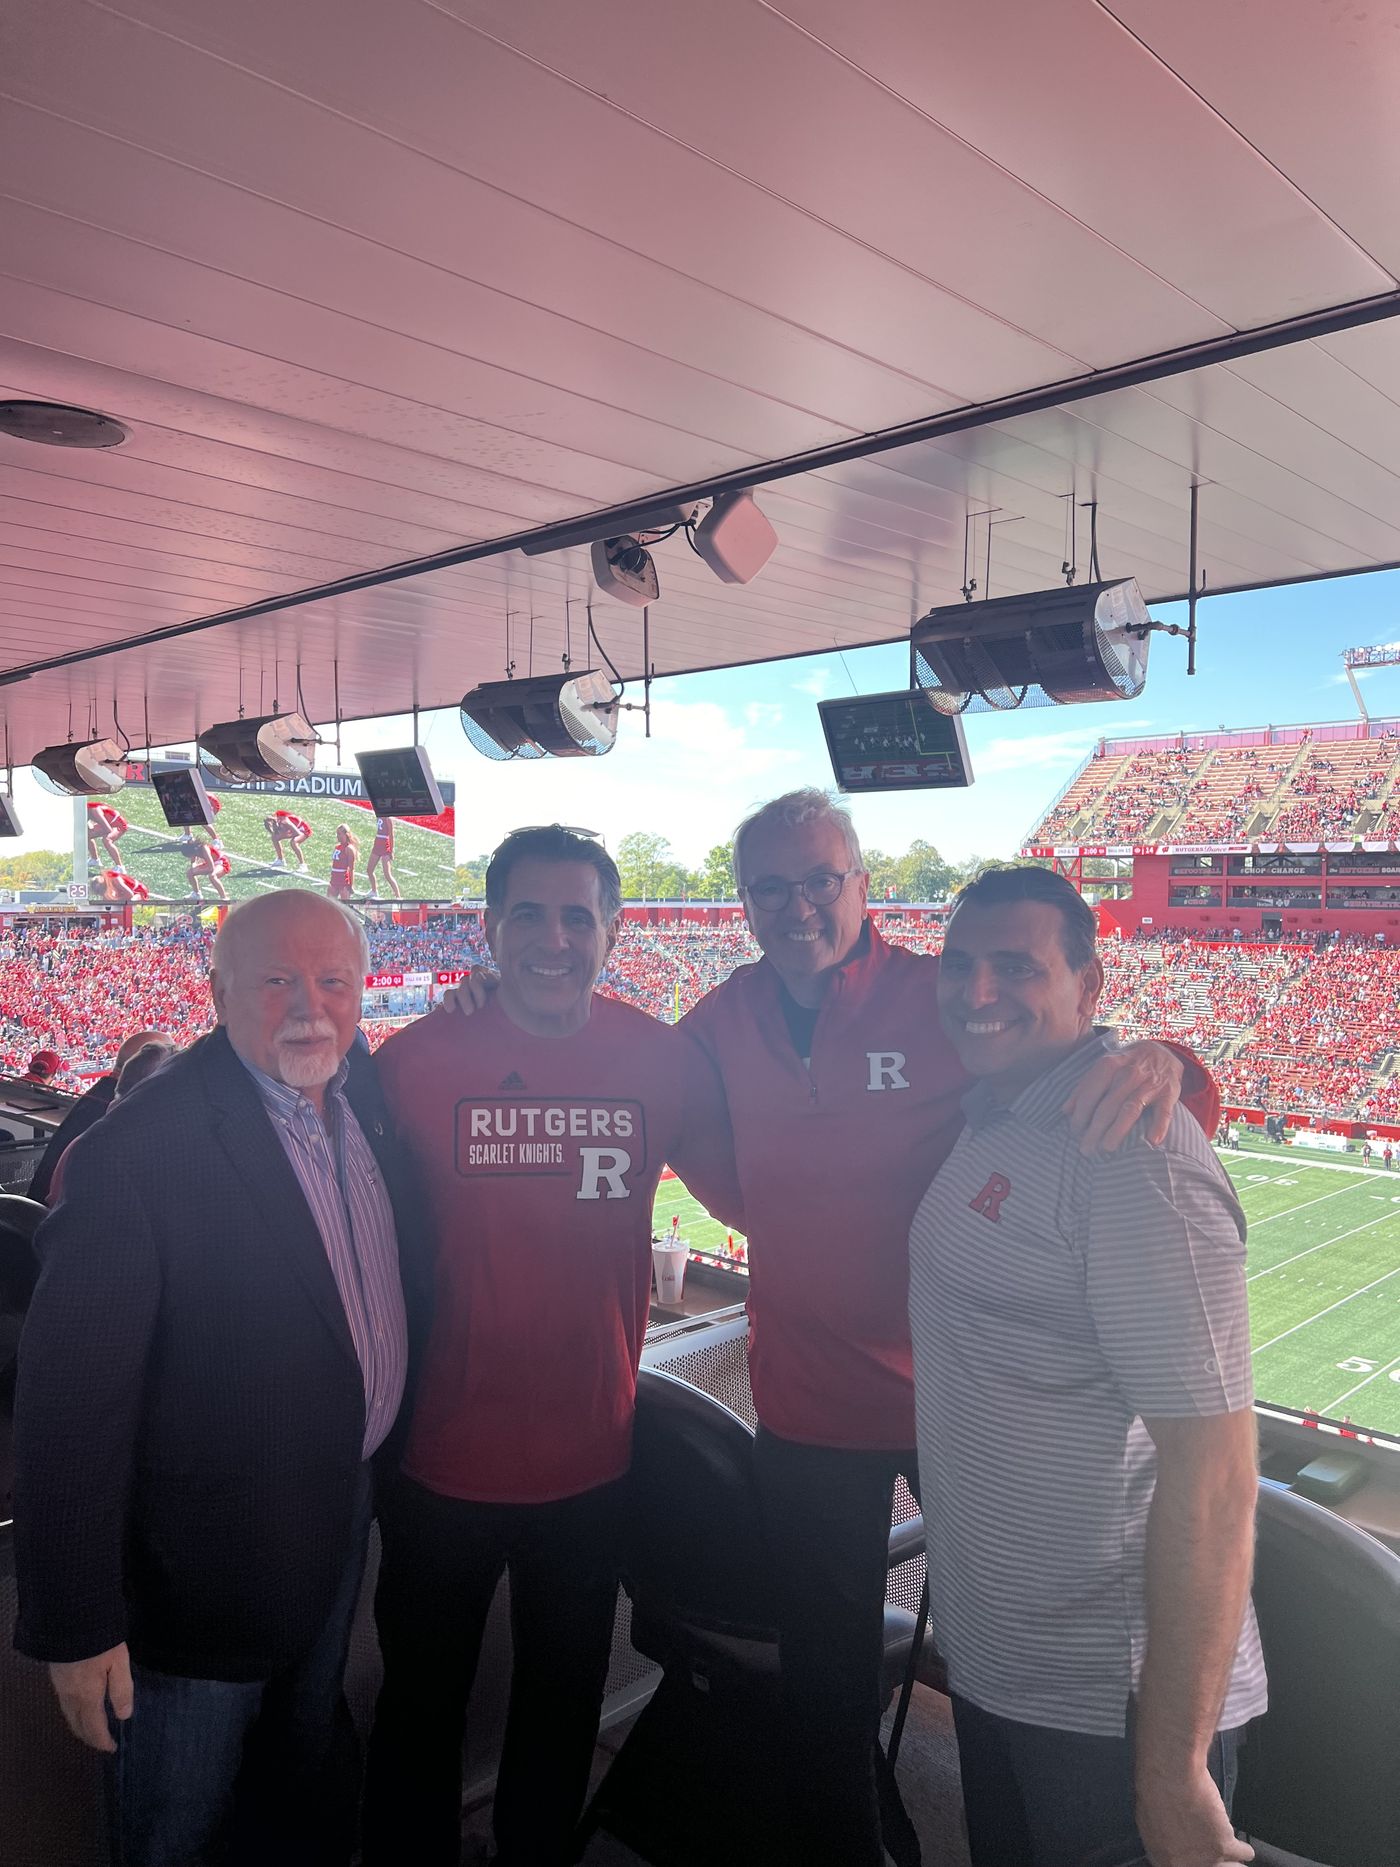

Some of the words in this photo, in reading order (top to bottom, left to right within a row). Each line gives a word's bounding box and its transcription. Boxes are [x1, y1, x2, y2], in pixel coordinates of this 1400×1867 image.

[274, 776, 362, 796] STADIUM
[70, 886, 86, 897] 25
[372, 976, 392, 986] 2:00
[866, 1052, 910, 1090] R
[471, 1108, 633, 1137] RUTGERS
[469, 1144, 515, 1165] SCARLET
[519, 1143, 563, 1164] KNIGHTS
[577, 1147, 631, 1199] R
[968, 1171, 1011, 1223] R
